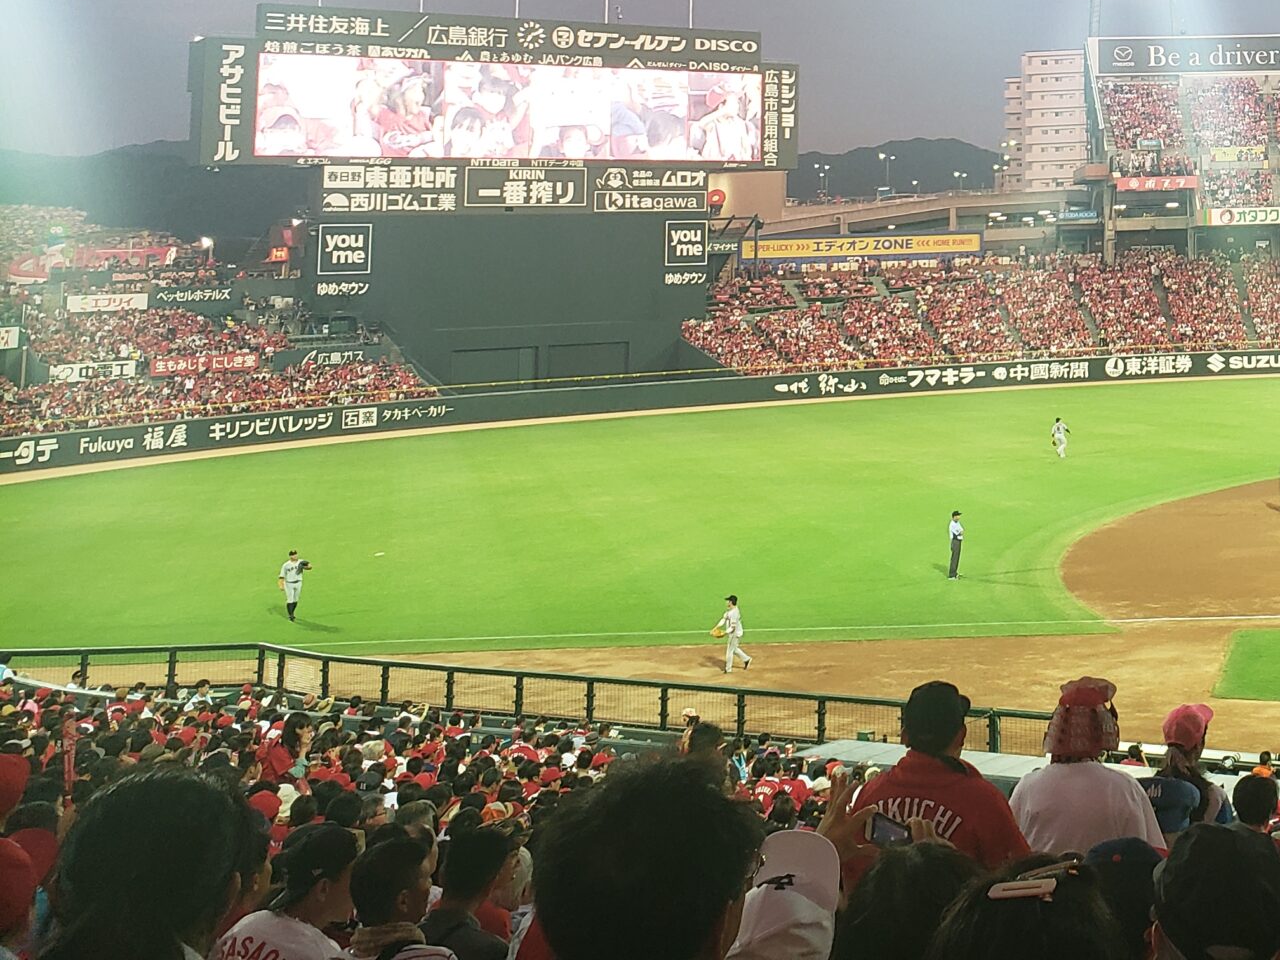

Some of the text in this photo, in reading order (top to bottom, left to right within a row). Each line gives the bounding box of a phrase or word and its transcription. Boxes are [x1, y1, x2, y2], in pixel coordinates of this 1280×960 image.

[264, 12, 390, 37] 三井住友海上
[427, 25, 509, 48] 広島銀行
[264, 41, 362, 56] 焙煎ごぼう茶
[695, 38, 758, 53] DISCO
[480, 51, 603, 67] 農とあゆむ JAバンク広島
[1148, 45, 1181, 67] Be
[1188, 51, 1202, 66] a
[689, 61, 730, 71] DAISO
[214, 44, 245, 162] アサヒビール
[764, 69, 780, 167] 広島市信用組合
[328, 171, 362, 182] 春日野
[365, 166, 458, 188] 東亜地所
[509, 170, 545, 180] KIRIN
[661, 171, 706, 187] ムロオ
[478, 181, 575, 205] 一番搾り
[350, 193, 457, 211] 西川ゴム工業
[1236, 209, 1280, 222] オタフク
[325, 234, 364, 251] you
[670, 229, 702, 246] you
[812, 240, 869, 252] エディオン
[873, 239, 913, 250] ZONE
[676, 244, 703, 256] me
[713, 243, 738, 251] マイナビ
[332, 250, 366, 264] me
[664, 272, 706, 285] ゆめタウン
[156, 288, 232, 302] ベッセルホテルズ
[317, 282, 369, 296] ゆめタウン
[155, 353, 256, 373] 生もみじ にしき堂
[317, 350, 364, 366] 広島ガス
[1125, 354, 1192, 375] 東洋証券
[78, 363, 130, 380] 中電工
[907, 367, 986, 388] フマキラー
[1009, 362, 1089, 381] 中國新聞
[382, 405, 454, 422] タカキベーカリー
[209, 413, 333, 442] キリンビバレッジ
[80, 426, 188, 455] Fukuya 福屋
[874, 796, 963, 838] IKUCHI
